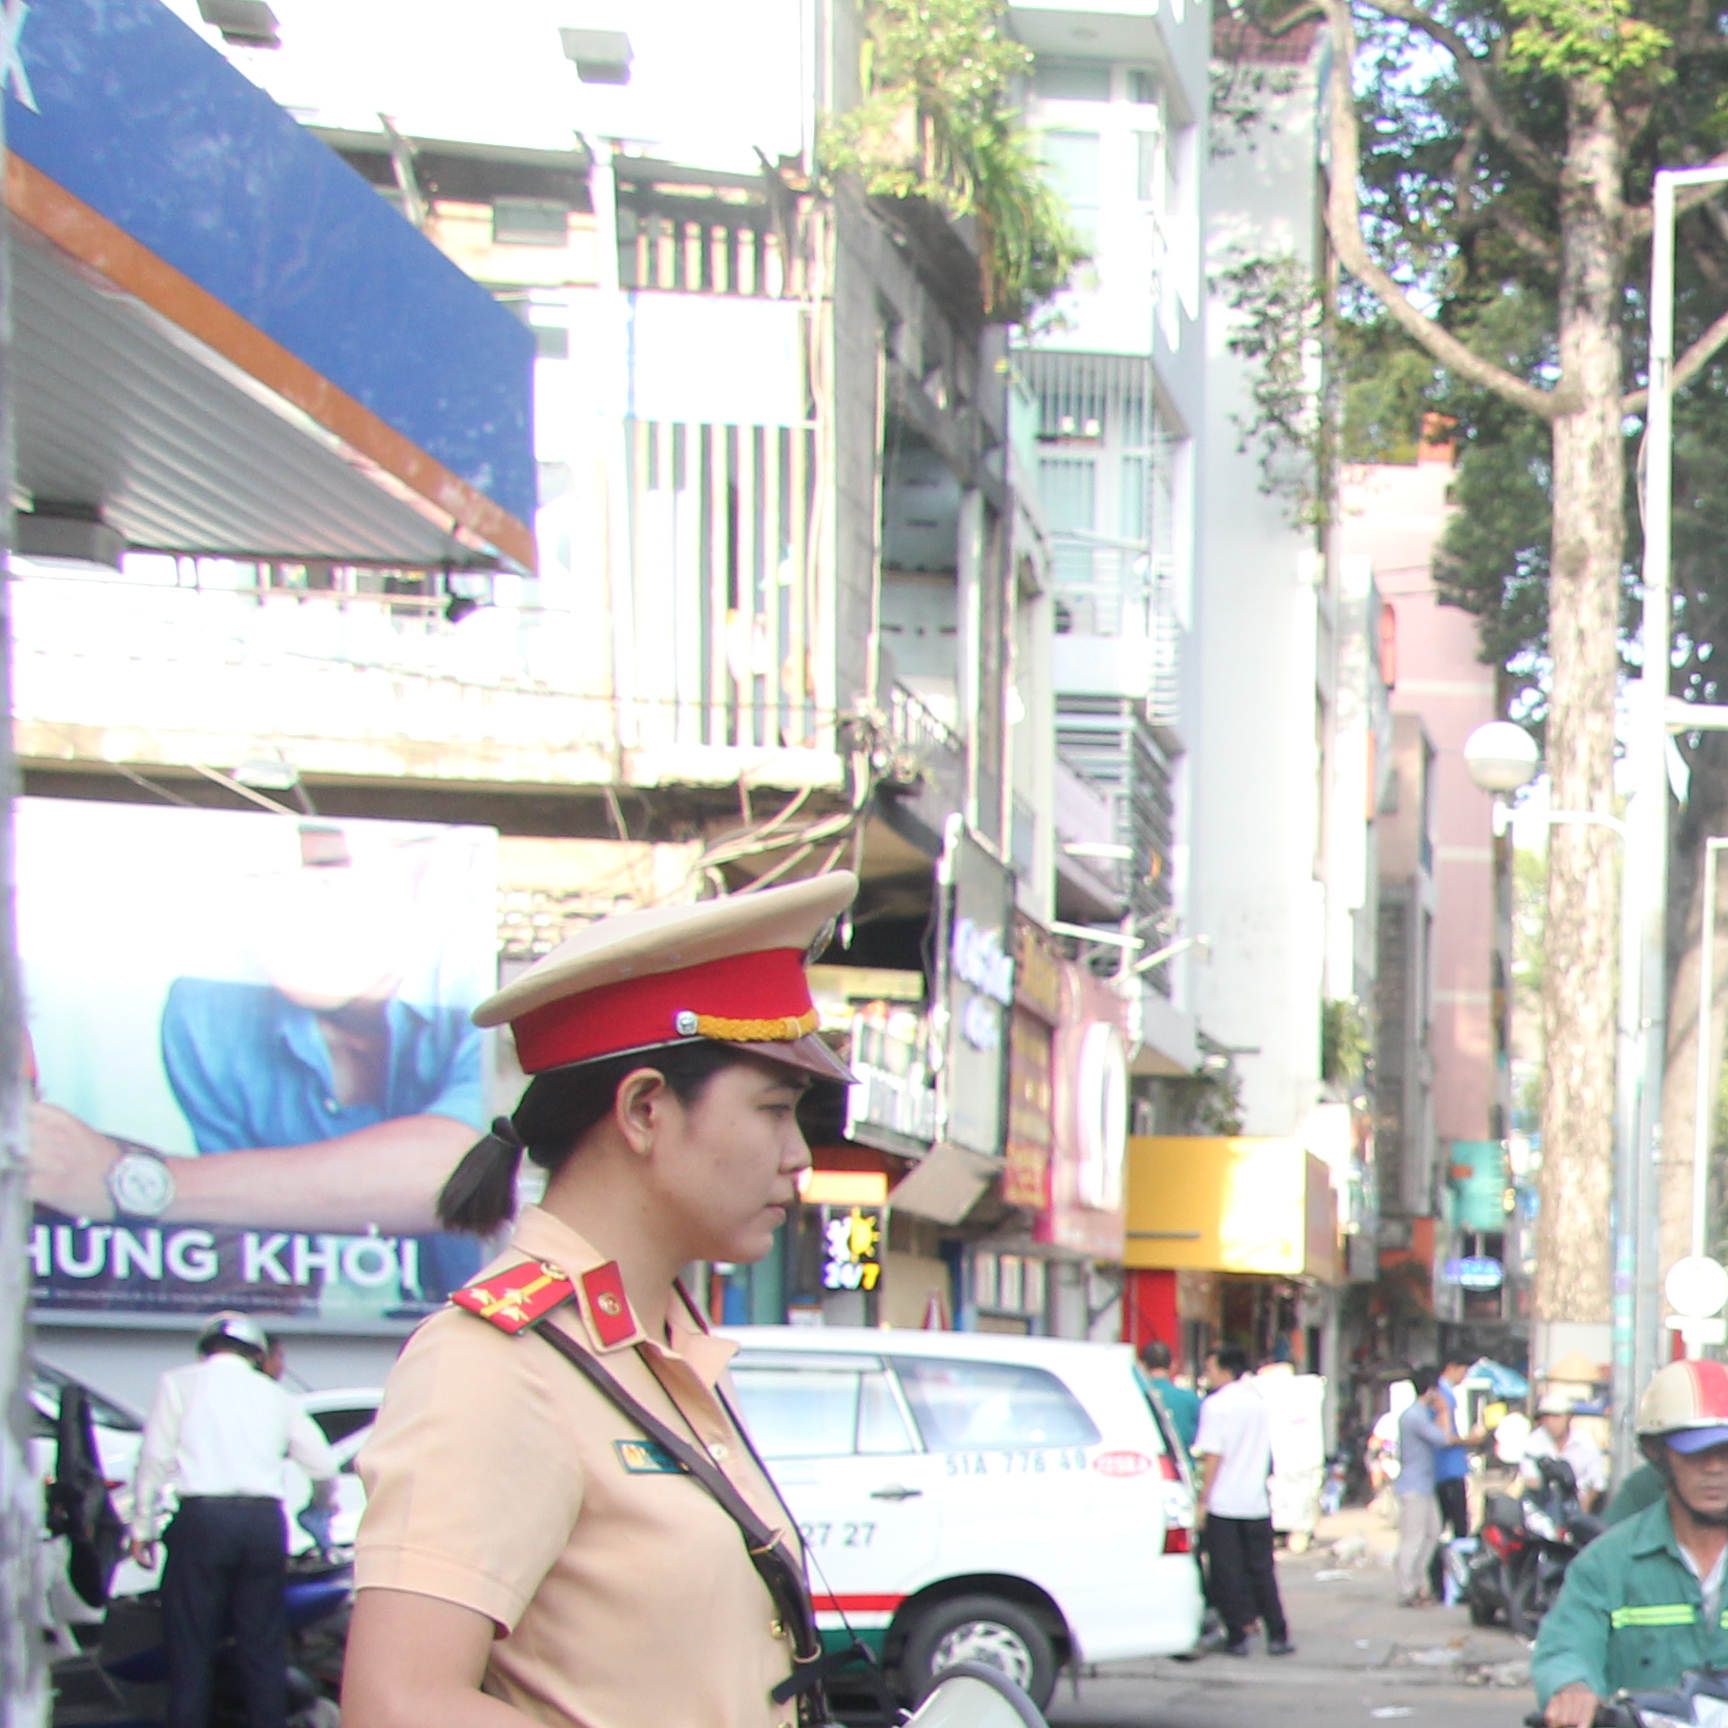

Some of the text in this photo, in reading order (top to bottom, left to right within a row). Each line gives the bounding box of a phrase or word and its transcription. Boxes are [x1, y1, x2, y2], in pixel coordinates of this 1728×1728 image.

[243, 1222, 420, 1289] KHỞI
[823, 1261, 881, 1290] 24/7
[946, 1451, 987, 1476] 51A
[1001, 1450, 1046, 1474] 776
[842, 1520, 875, 1547] 27
